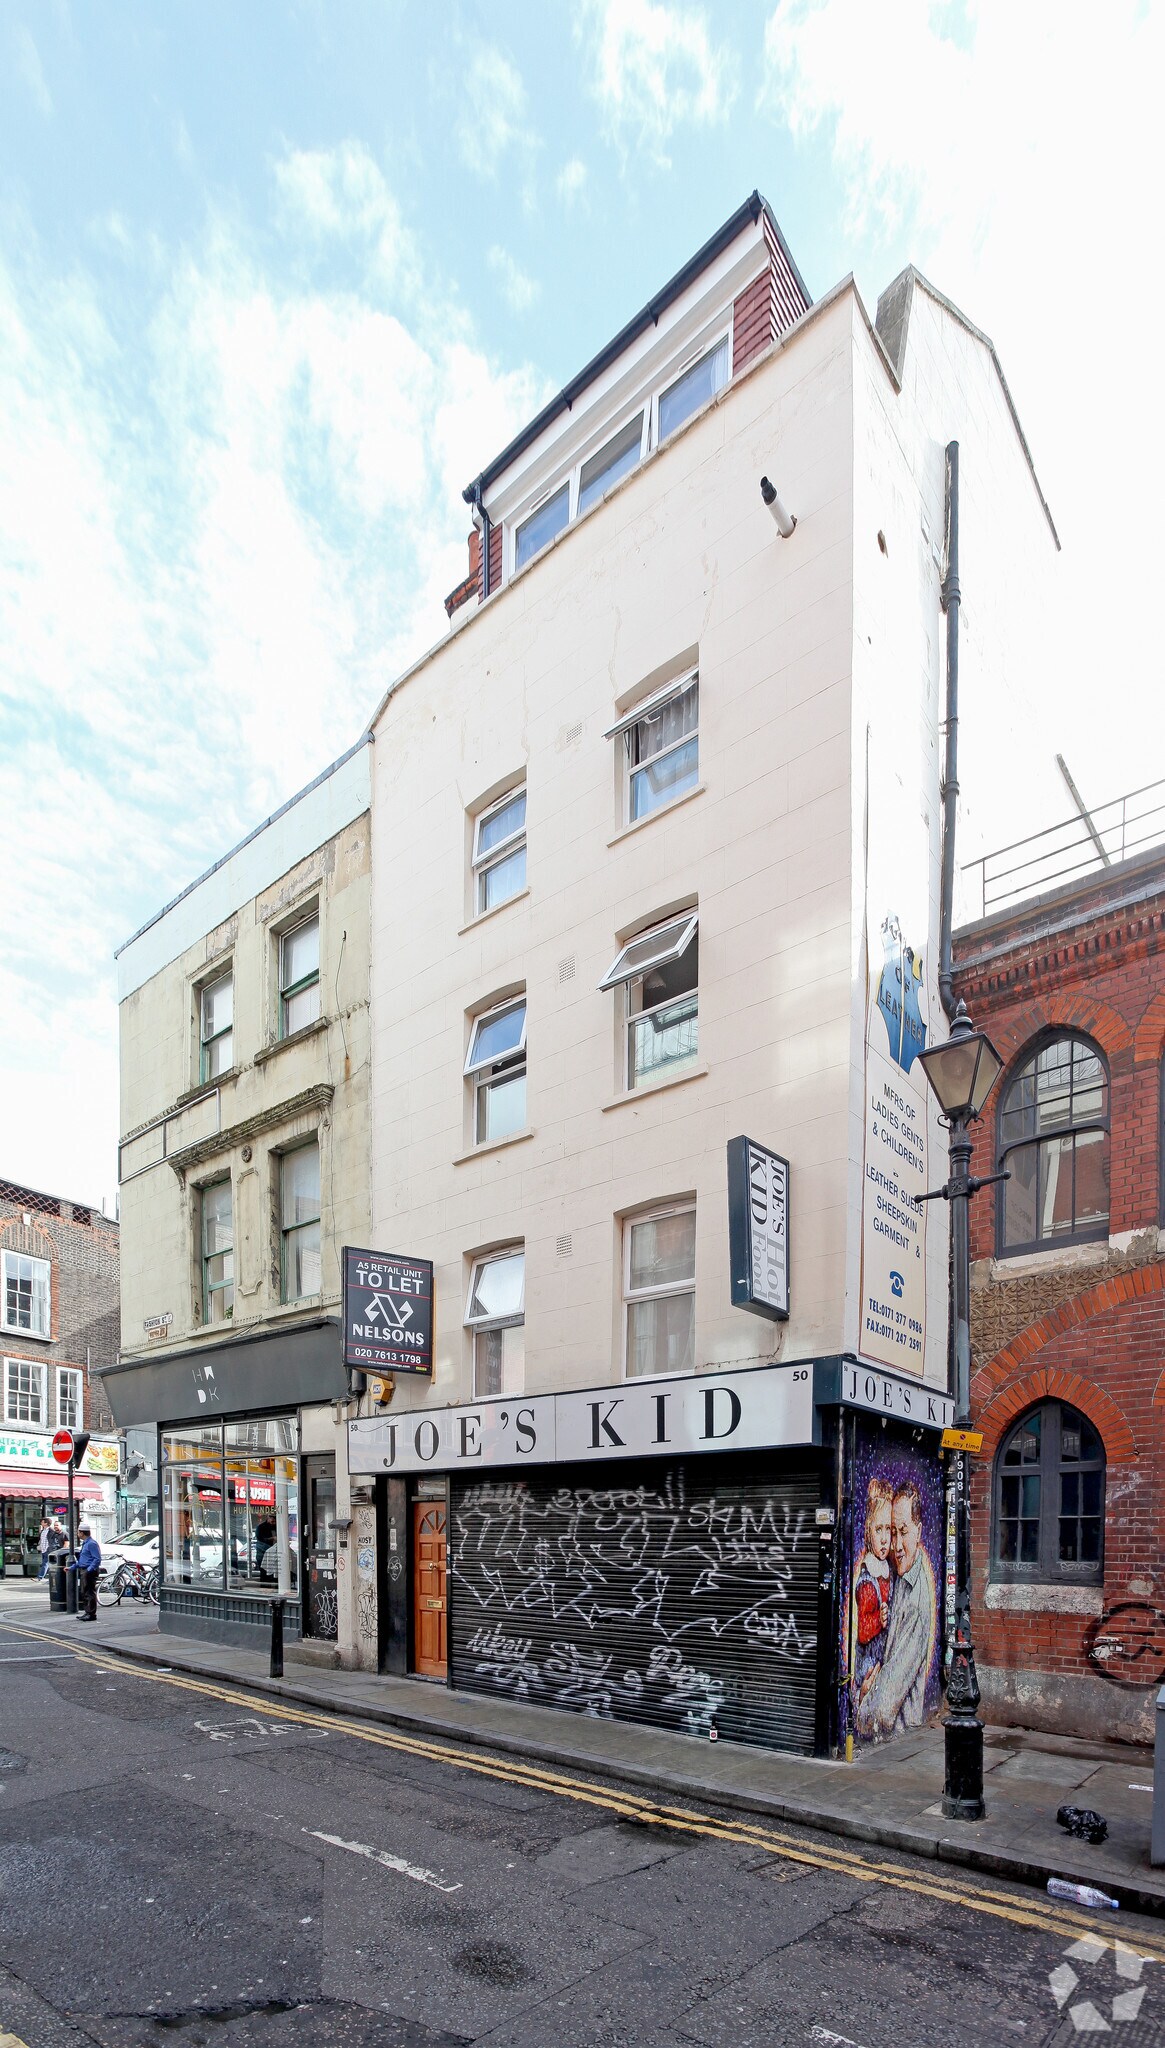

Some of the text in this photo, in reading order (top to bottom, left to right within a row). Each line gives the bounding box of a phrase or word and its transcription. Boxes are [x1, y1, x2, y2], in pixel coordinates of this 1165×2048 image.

[871, 1095, 924, 1152] LADIES GENTS
[872, 1121, 924, 1174] & CHILDREN'S
[750, 1149, 768, 1226] KID
[771, 1159, 785, 1236] JOE'S
[866, 1162, 924, 1218] LEATHER SUEDE
[876, 1195, 918, 1234] SHEEPSKIN
[873, 1216, 921, 1259] GARMENT &
[355, 1269, 424, 1294] TO LET
[357, 1261, 422, 1279] A5 RETAIL UNIT
[752, 1228, 767, 1300] Food
[767, 1232, 785, 1305] Hot
[352, 1323, 425, 1346] NELSONS
[895, 1311, 907, 1326] 377
[355, 1347, 421, 1364] 020 7613 1798
[895, 1330, 907, 1346] 247
[908, 1336, 922, 1353] 2591
[792, 1370, 809, 1382] 50
[849, 1370, 956, 1425] JOE'S KI
[383, 1386, 742, 1468] JOE'S KID
[952, 1441, 964, 1449] any
[965, 1440, 980, 1450] time
